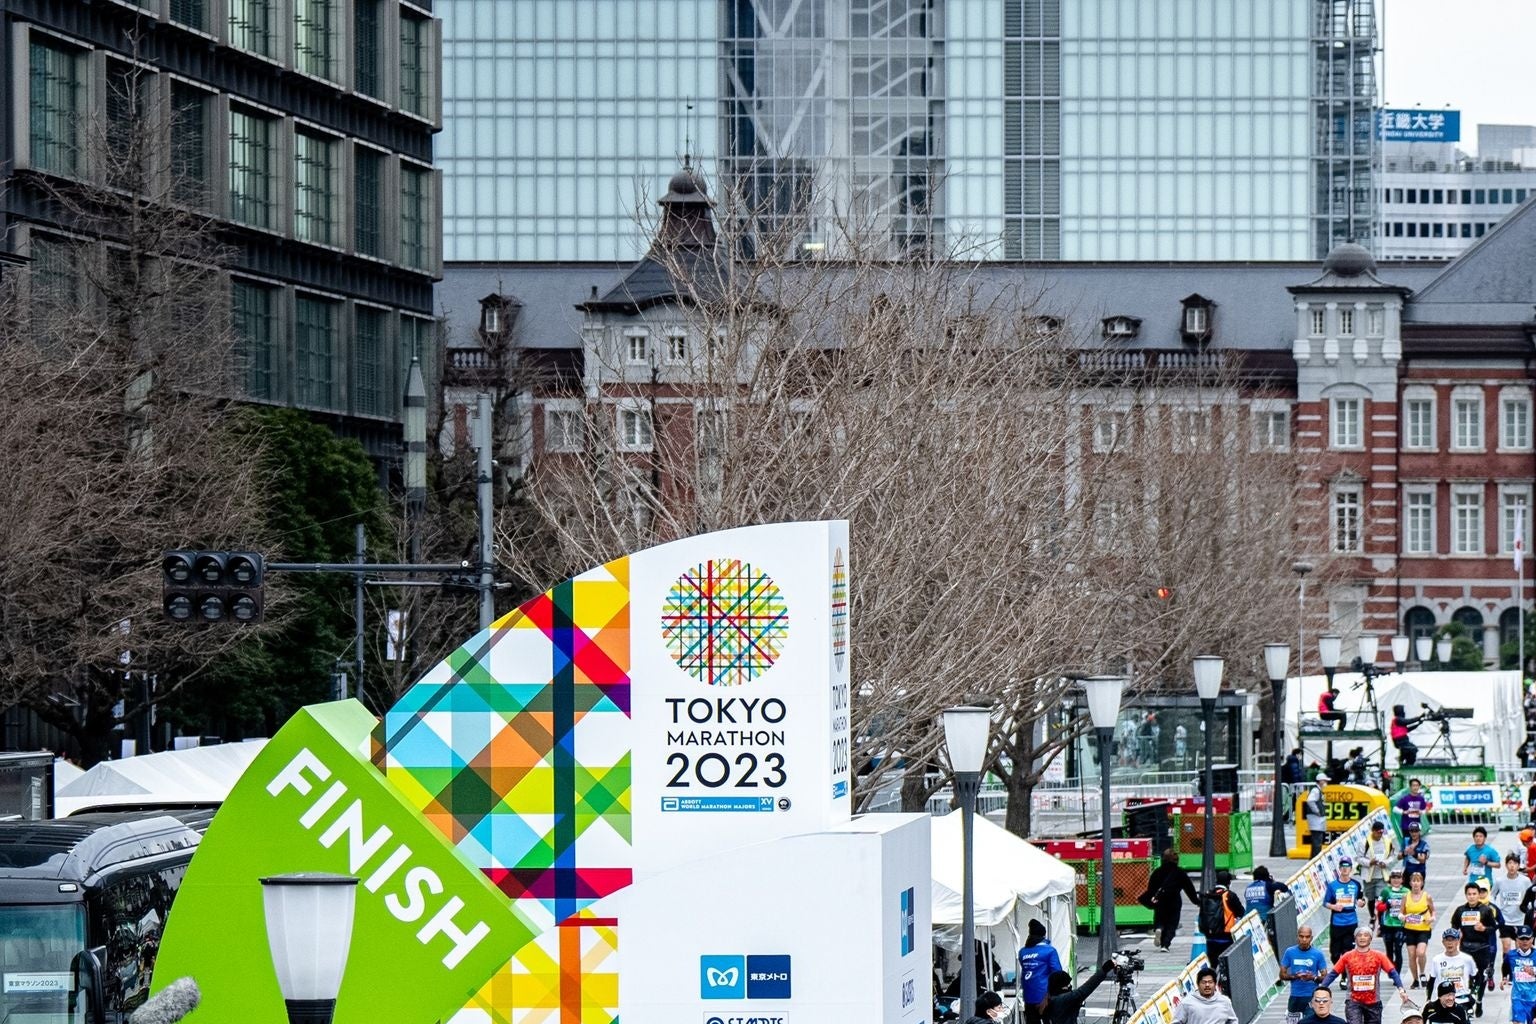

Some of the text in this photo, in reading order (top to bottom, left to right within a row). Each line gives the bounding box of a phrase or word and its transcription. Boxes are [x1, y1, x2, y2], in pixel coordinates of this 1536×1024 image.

[665, 698, 787, 723] TOKYO
[667, 731, 785, 746] MARATHON
[666, 752, 787, 788] 2023
[266, 747, 491, 970] FINISH
[8, 979, 59, 988] 東京マラソン2023
[750, 972, 788, 981] 東京メトロ
